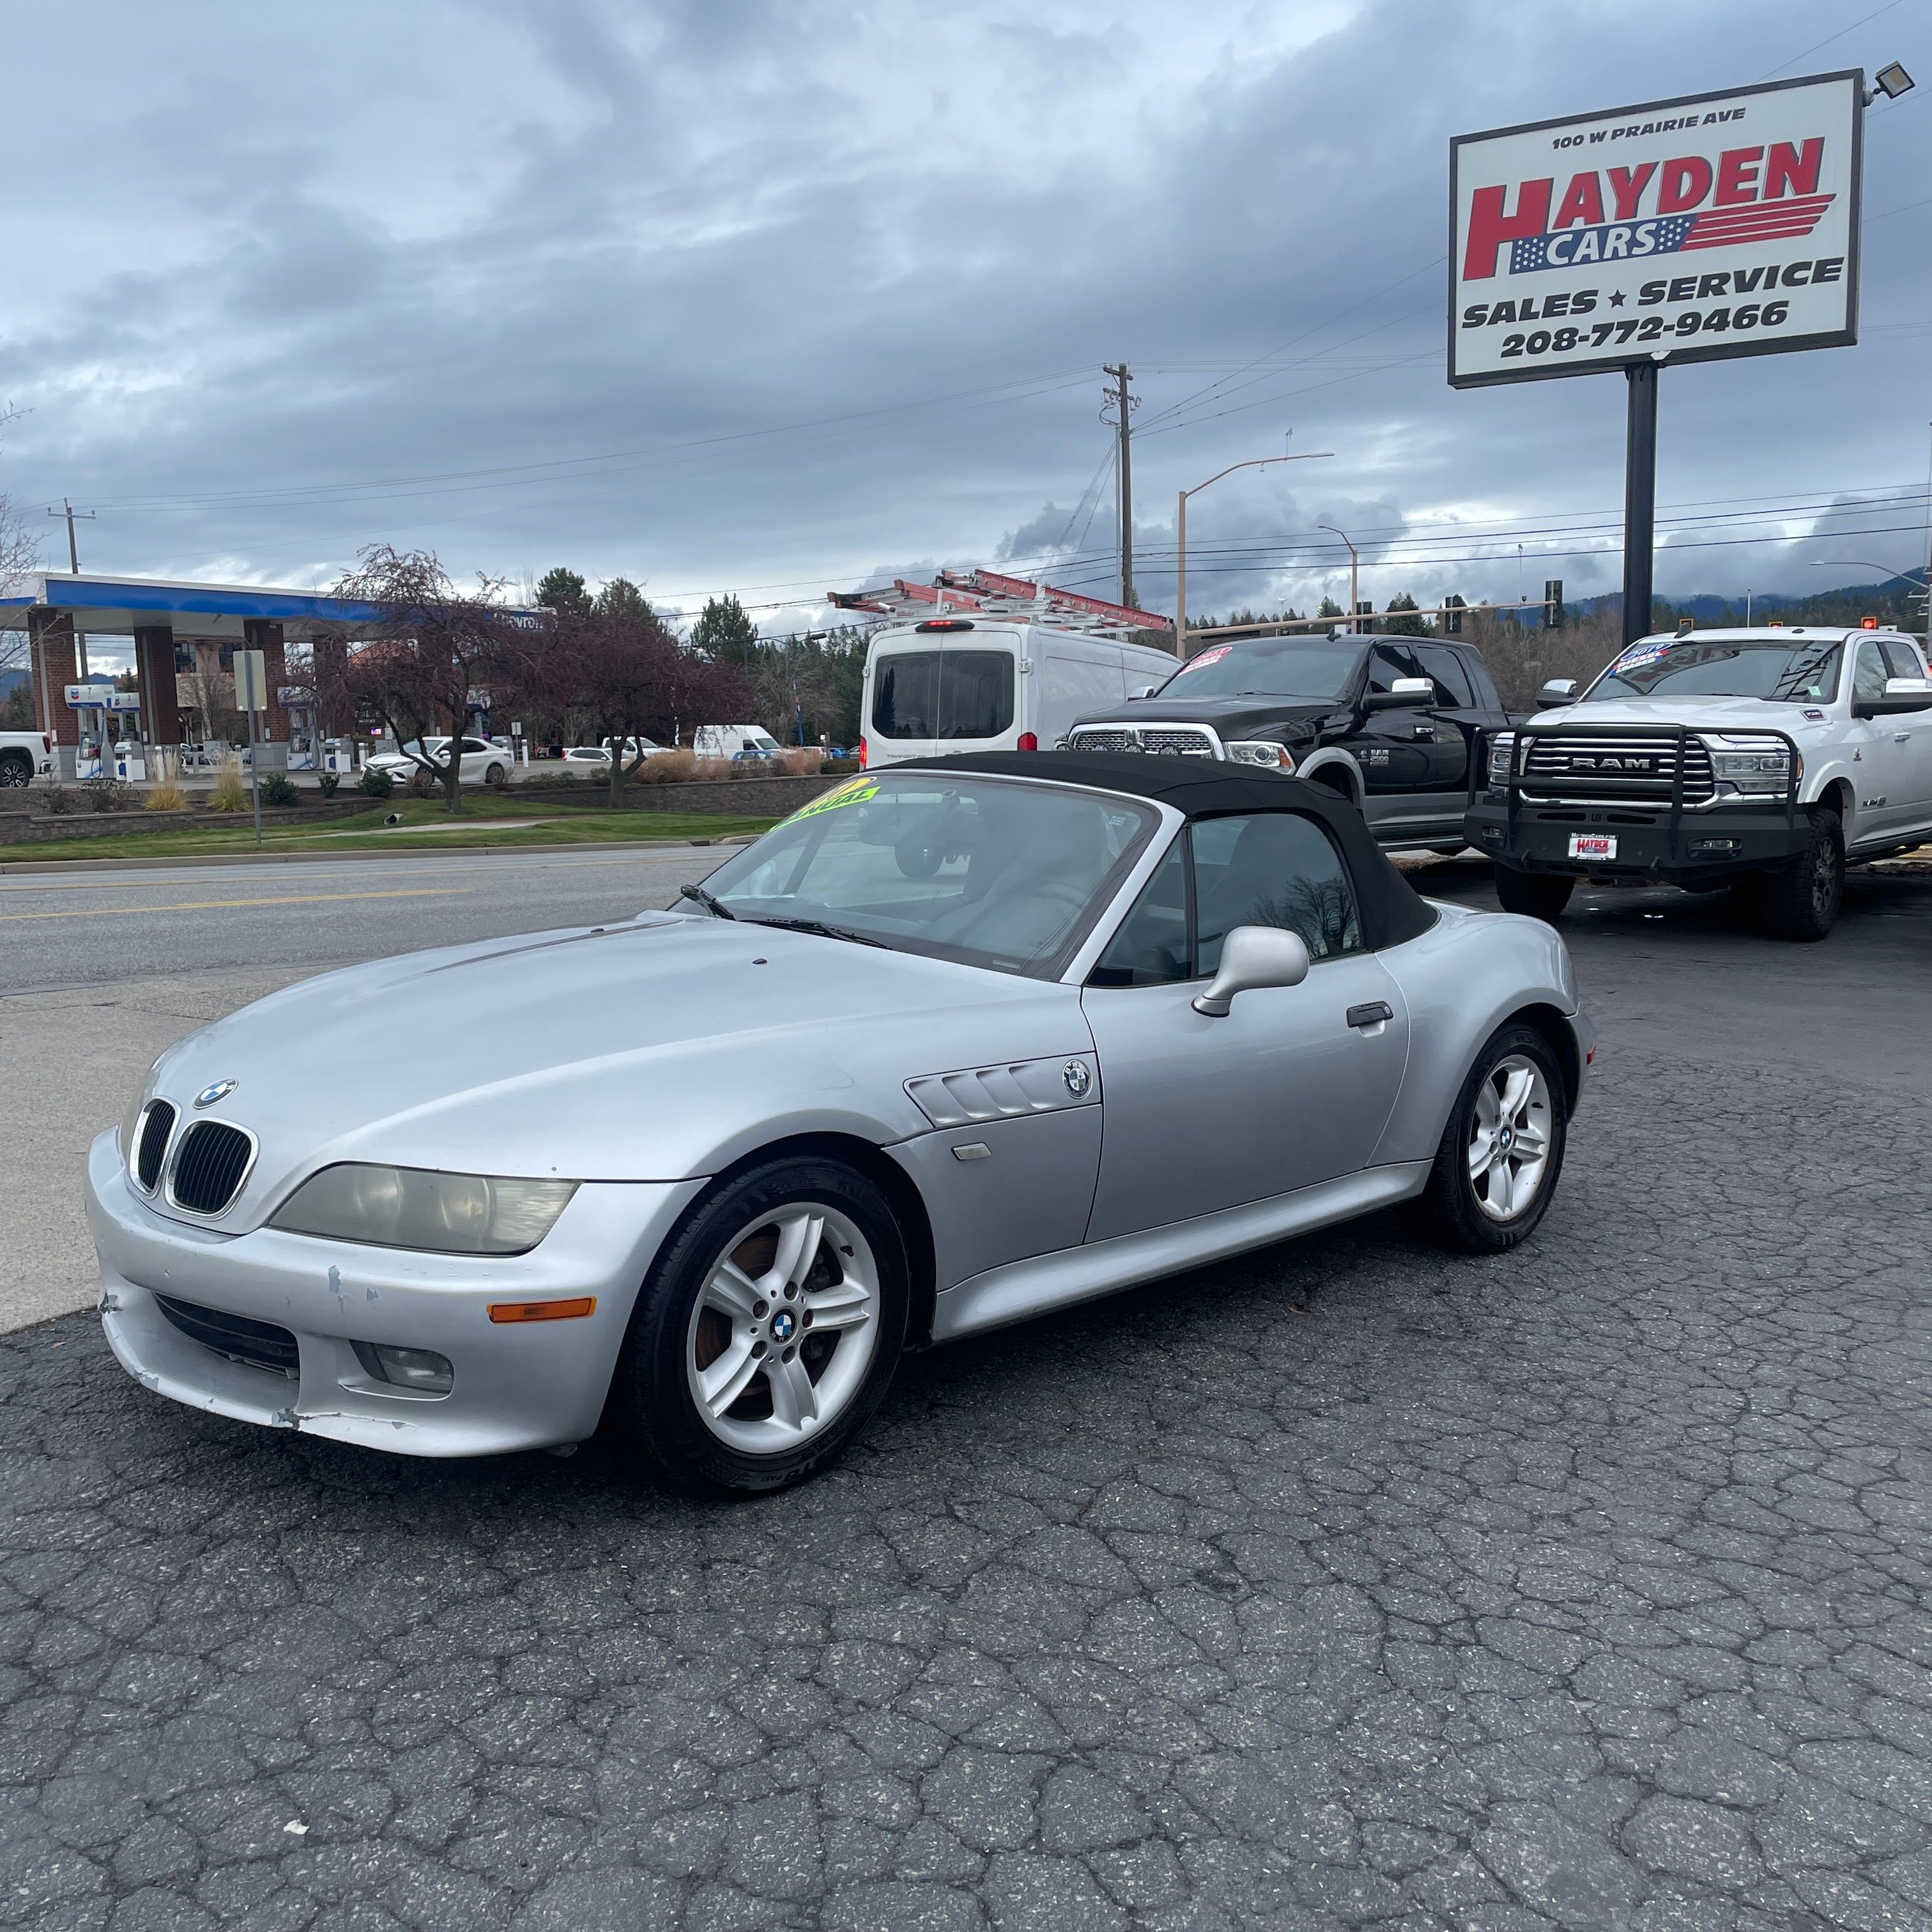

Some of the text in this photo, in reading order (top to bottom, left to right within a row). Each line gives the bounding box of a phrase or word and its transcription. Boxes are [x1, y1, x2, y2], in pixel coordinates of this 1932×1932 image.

[1552, 107, 1747, 150] 100 W PRAIRIE AVE
[1462, 136, 1825, 282] HAYDEN
[1545, 222, 1658, 266] CARS
[1461, 256, 1845, 329] SALES SERVICE
[1500, 300, 1790, 358] 208-772-9466
[87, 687, 92, 695] 7
[1572, 758, 1651, 769] RAM
[1576, 839, 1609, 853] HAYDEN
